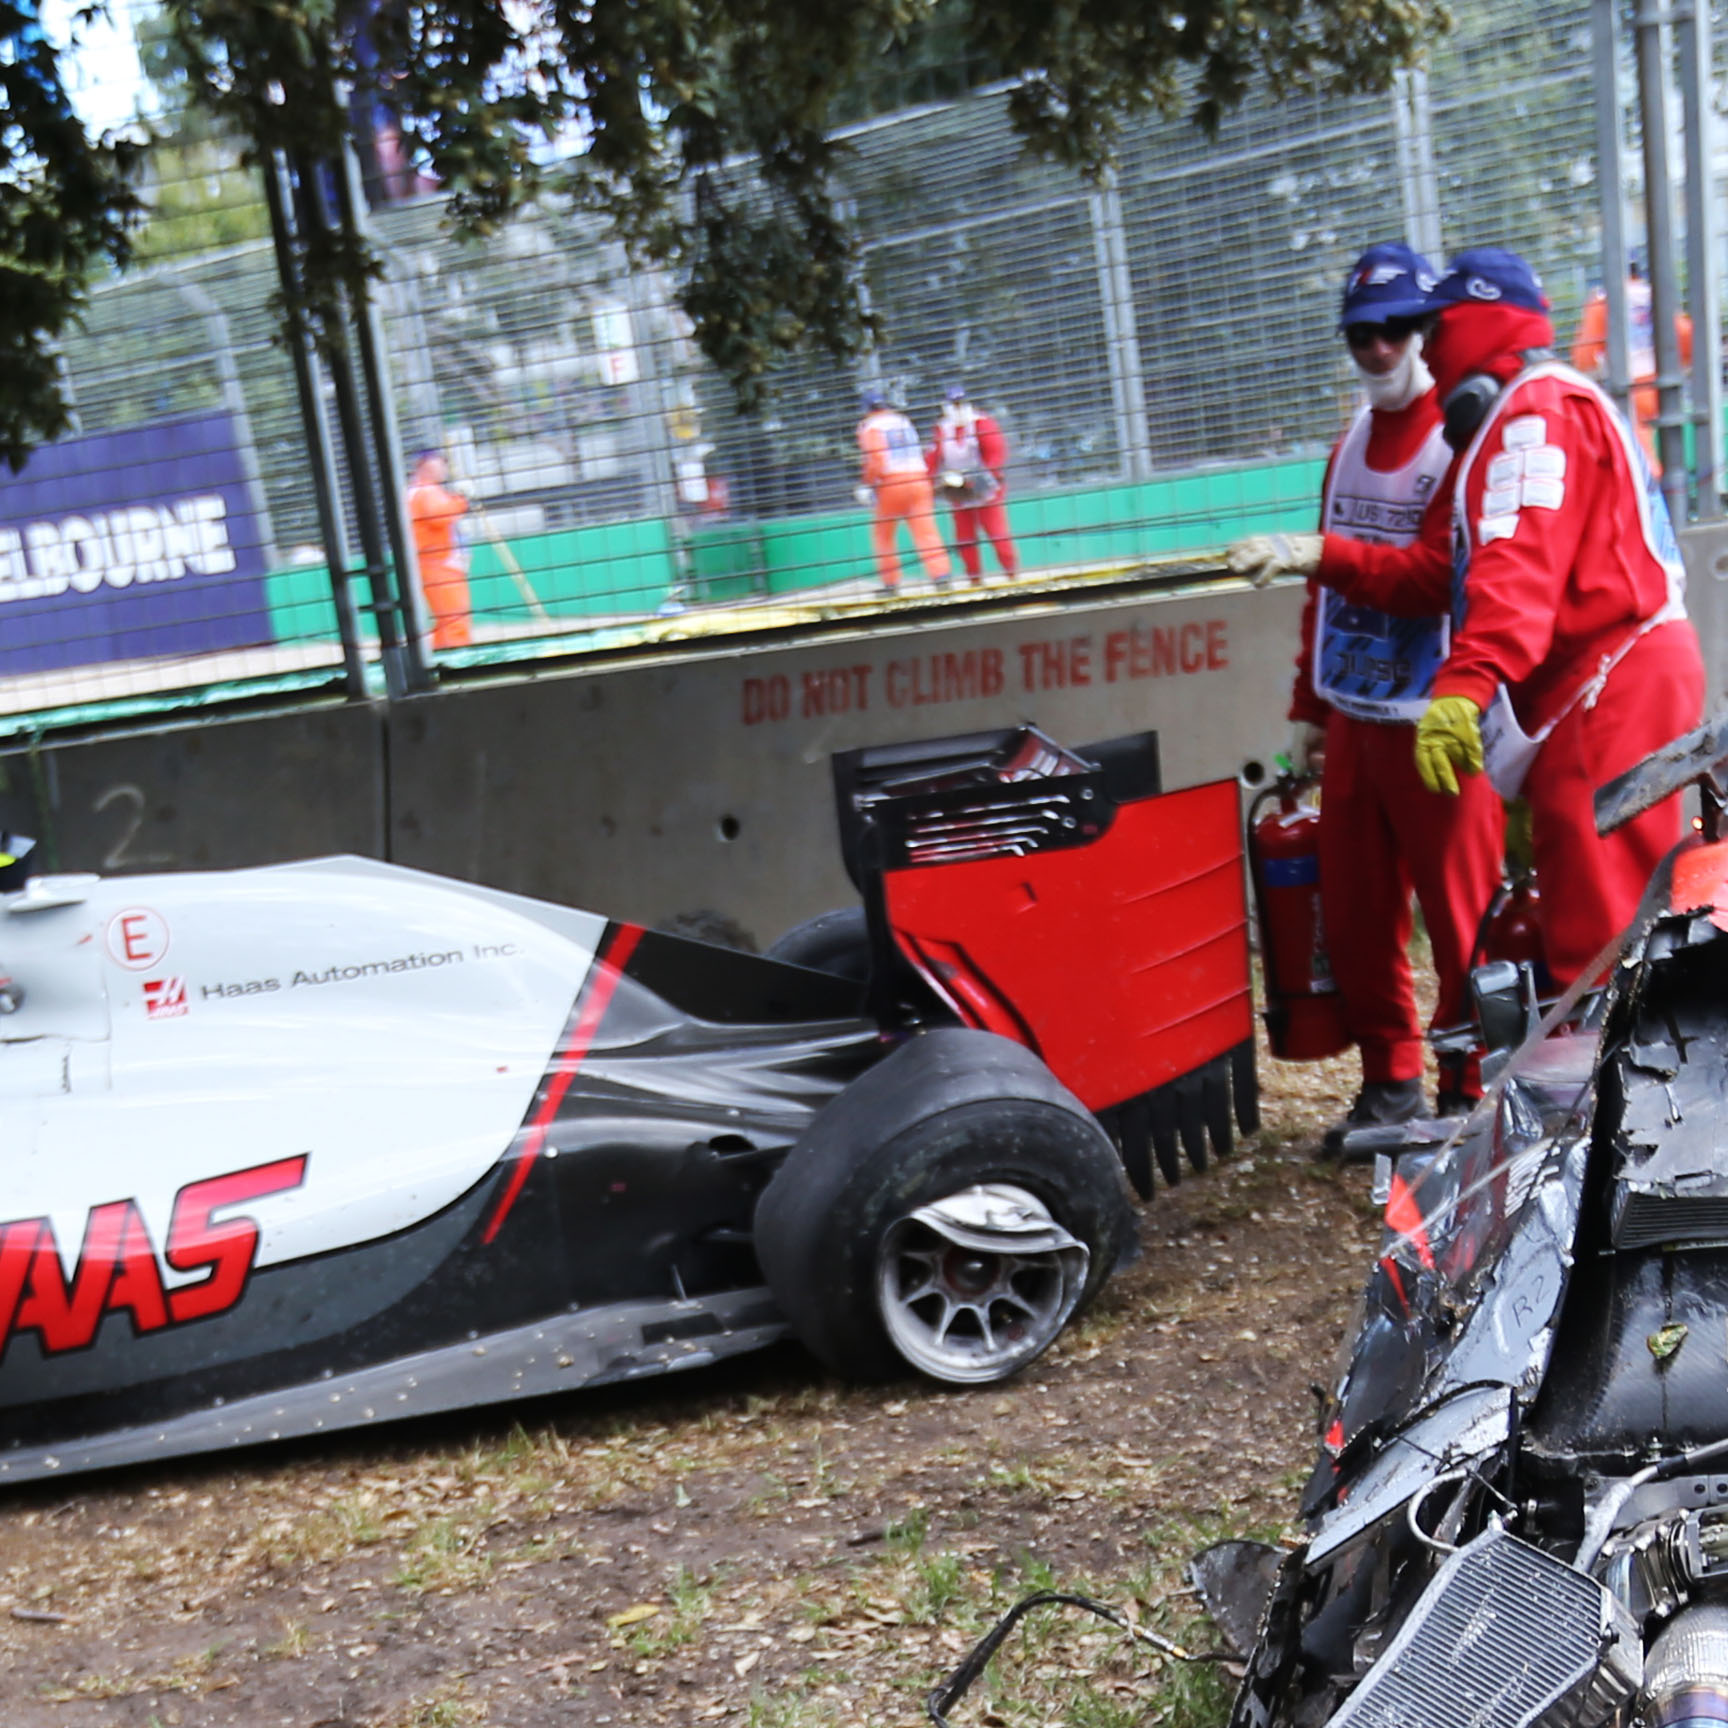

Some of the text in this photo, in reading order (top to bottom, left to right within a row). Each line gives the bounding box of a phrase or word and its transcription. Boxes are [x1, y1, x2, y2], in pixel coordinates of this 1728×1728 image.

[742, 619, 1229, 726] DO NOT CLIMB THE FENCE
[120, 915, 152, 962] E
[200, 941, 525, 1002] Haas Automation Inc.
